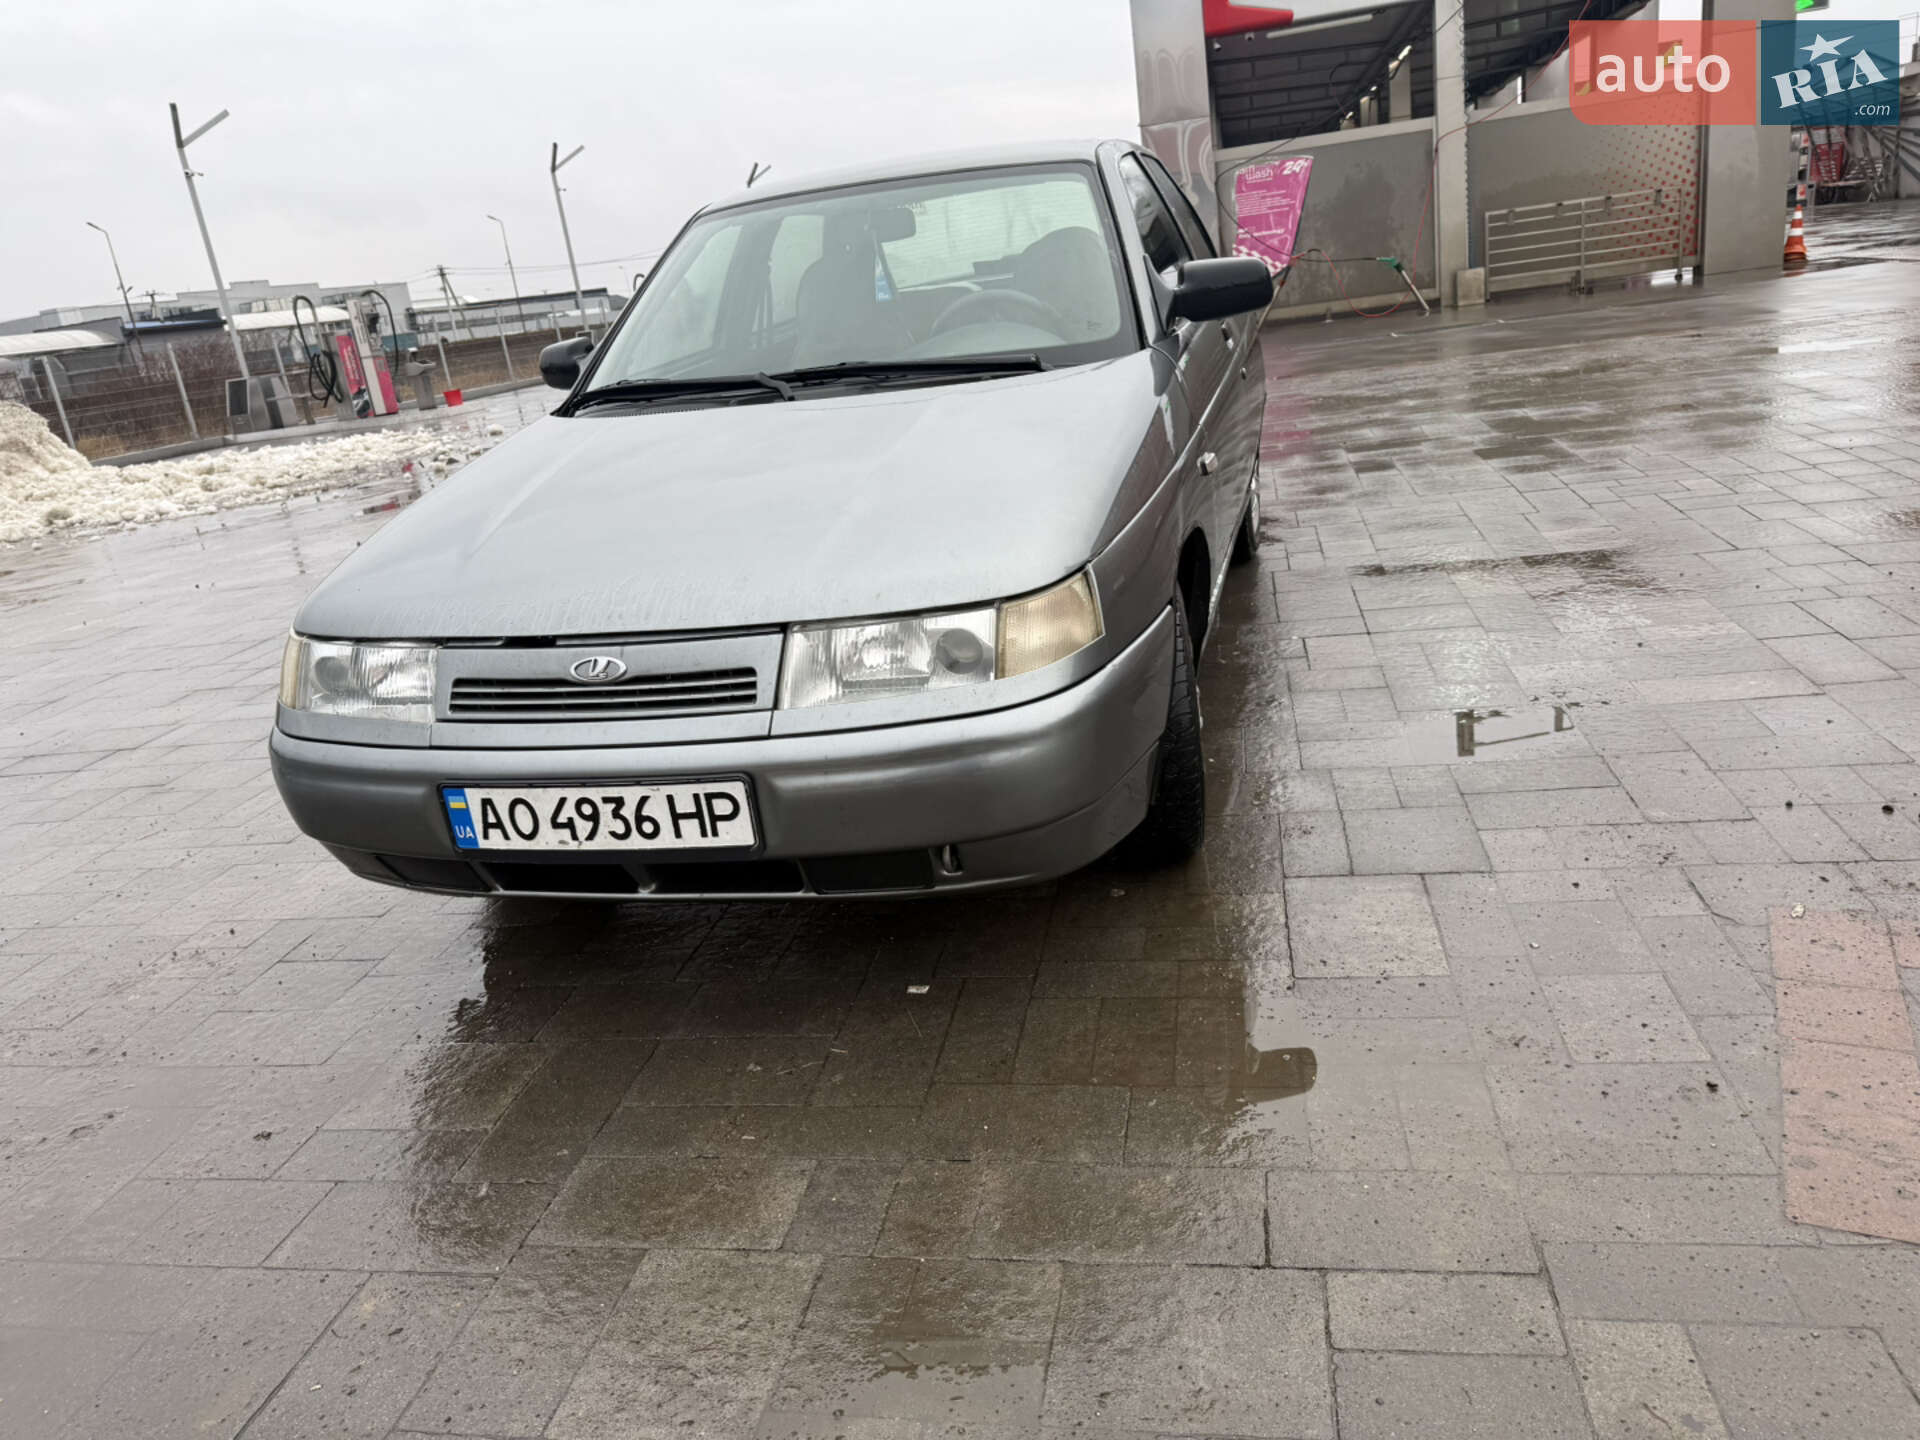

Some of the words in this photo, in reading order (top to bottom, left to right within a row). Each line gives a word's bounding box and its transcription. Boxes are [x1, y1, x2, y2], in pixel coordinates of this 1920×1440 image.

[455, 825, 475, 840] UA
[481, 797, 540, 841] AO
[551, 795, 661, 841] 4936
[666, 792, 741, 839] HP
